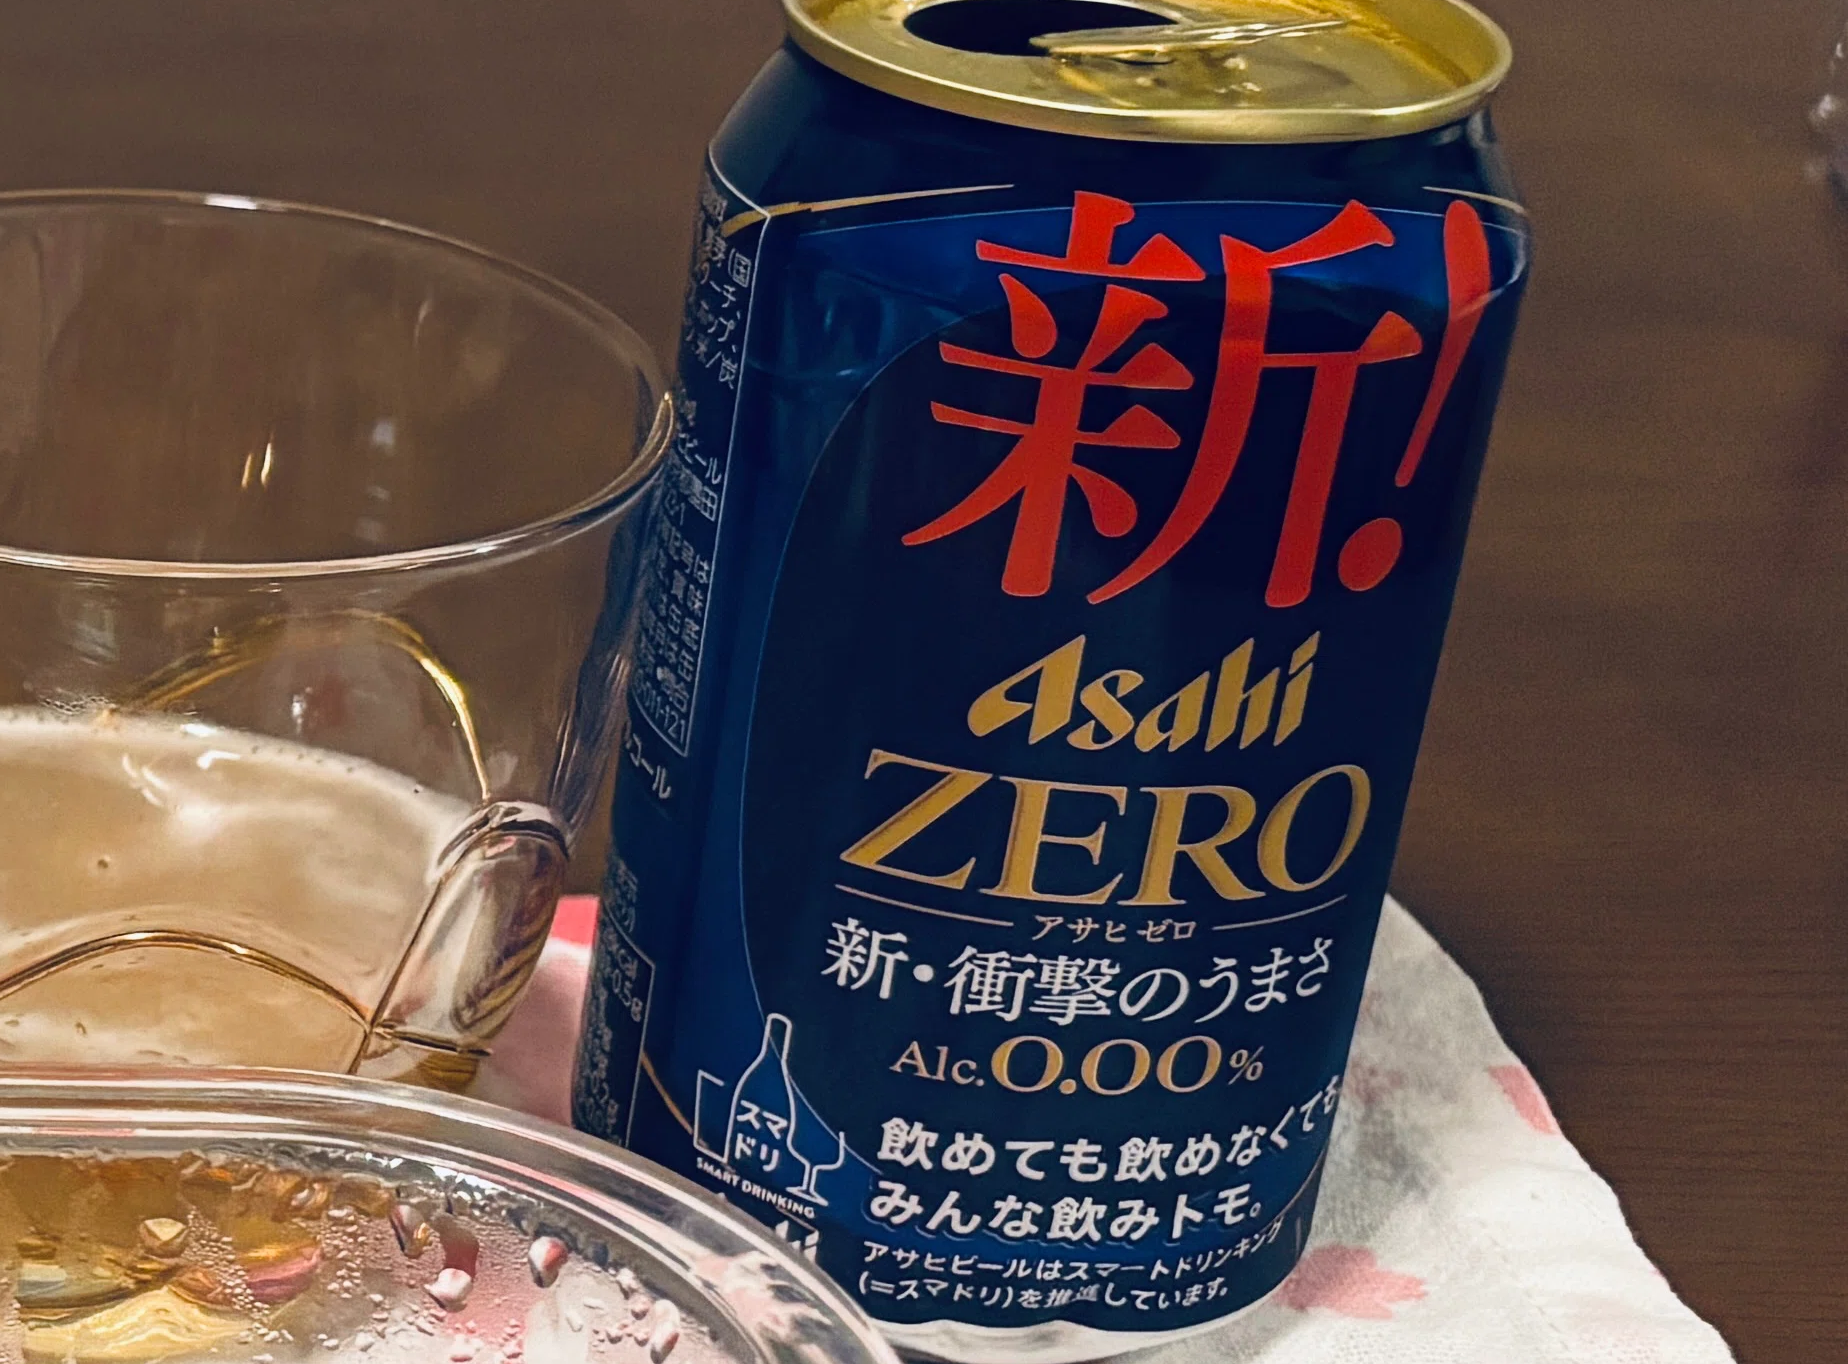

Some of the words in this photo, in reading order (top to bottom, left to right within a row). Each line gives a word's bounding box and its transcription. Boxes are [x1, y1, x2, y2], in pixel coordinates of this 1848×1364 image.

[901, 190, 1491, 607] 新!
[967, 631, 1321, 753] Asahi
[839, 748, 1372, 906] ZERO
[696, 1156, 741, 1187] SMART
[741, 1180, 816, 1220] DRINKING
